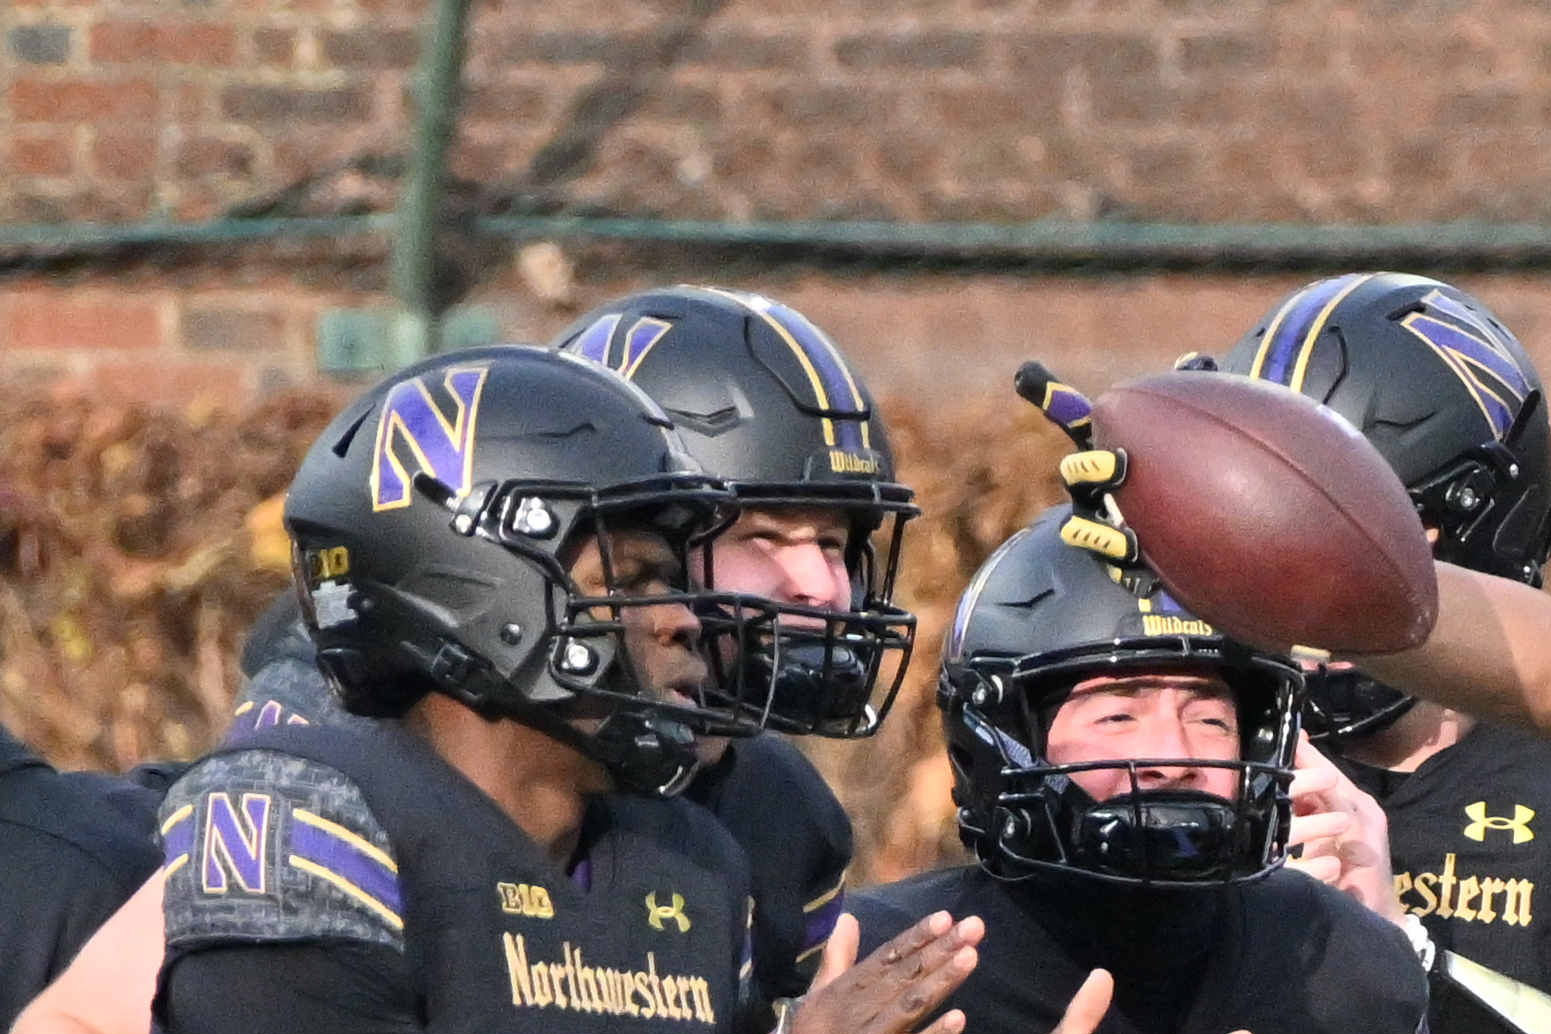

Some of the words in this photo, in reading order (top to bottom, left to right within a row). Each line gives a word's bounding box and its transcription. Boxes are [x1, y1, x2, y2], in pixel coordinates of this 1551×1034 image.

[1401, 288, 1536, 443] N
[371, 365, 490, 512] N
[202, 792, 271, 894] N
[1394, 853, 1534, 927] estern
[502, 931, 717, 1025] Northwestern
